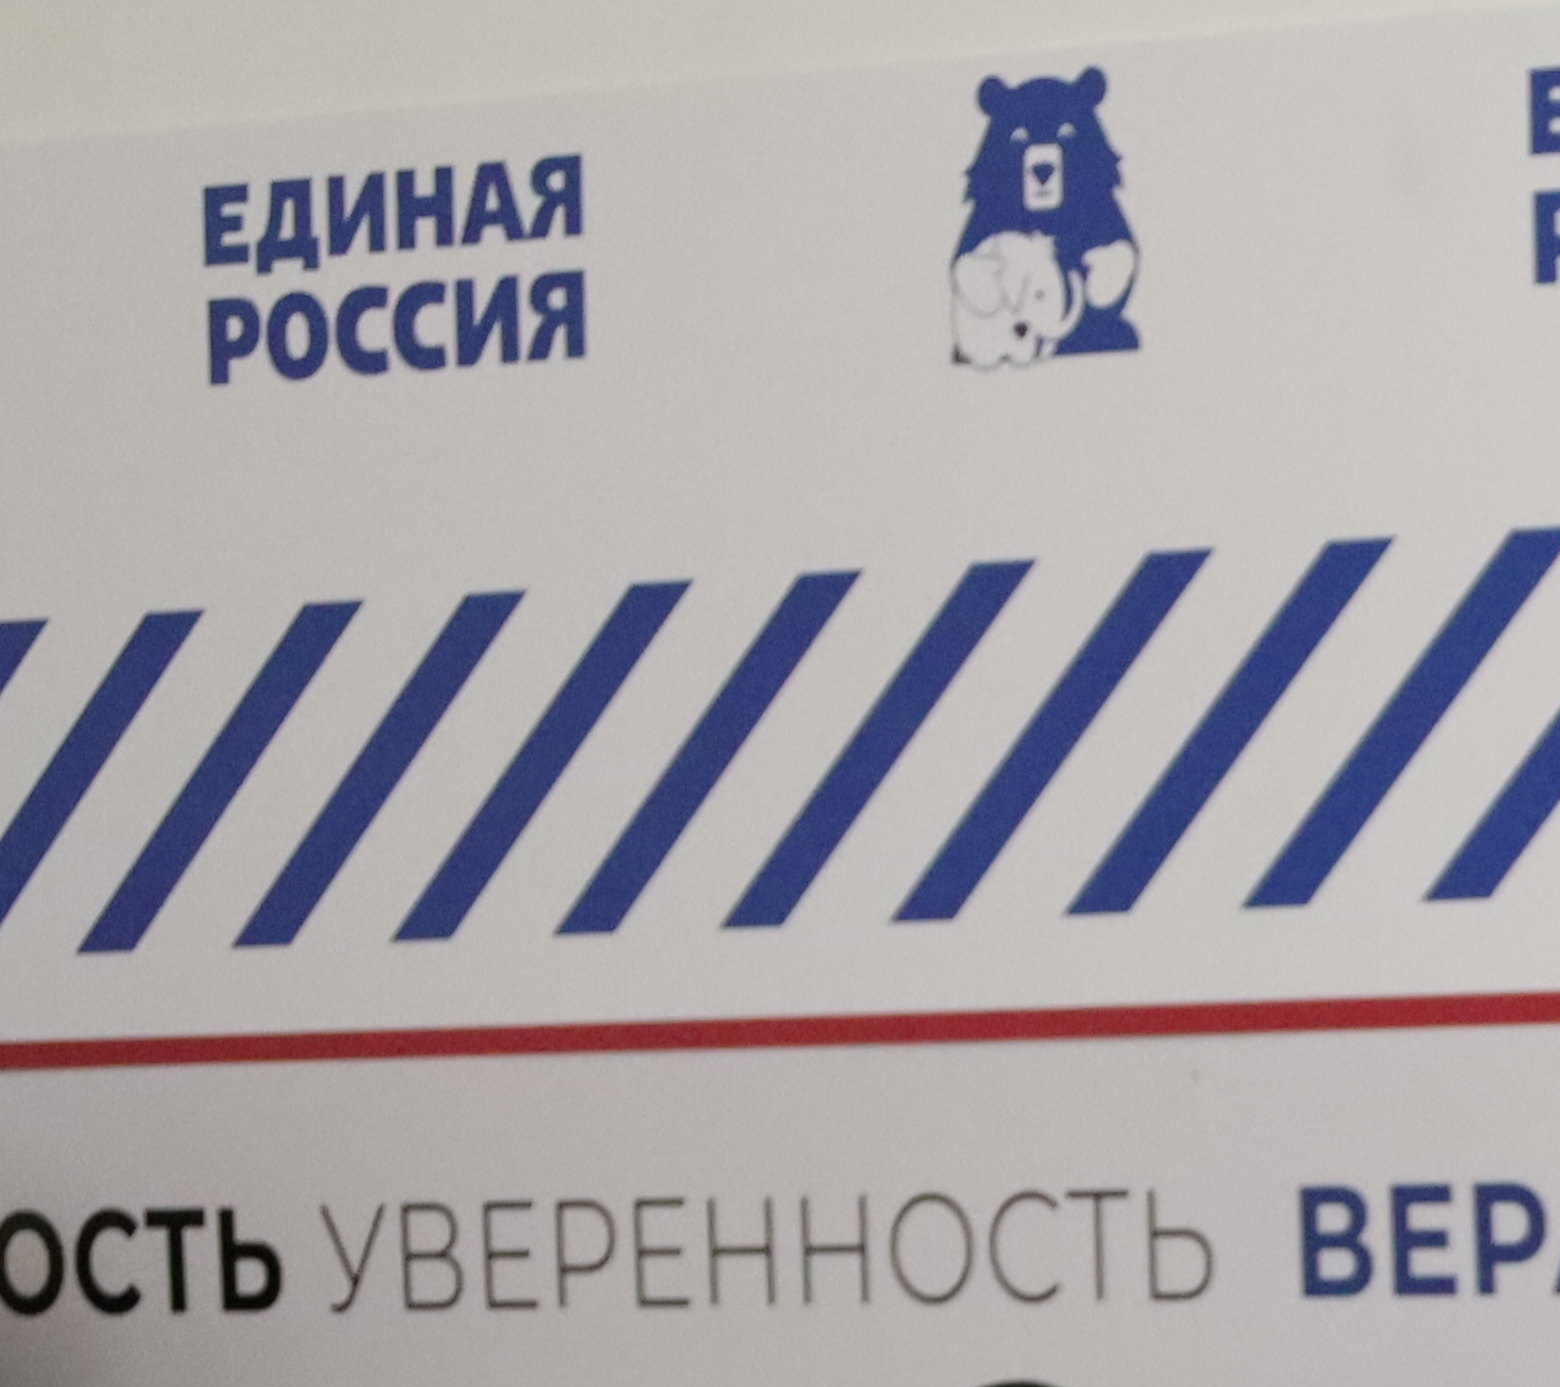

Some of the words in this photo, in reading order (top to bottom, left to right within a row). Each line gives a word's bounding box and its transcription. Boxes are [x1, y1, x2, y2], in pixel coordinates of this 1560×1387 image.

[204, 155, 584, 272] ЕДИНАЯ
[207, 270, 586, 385] РОССИЯ
[320, 1186, 1216, 1312] УВЕРЕННОСТЬ
